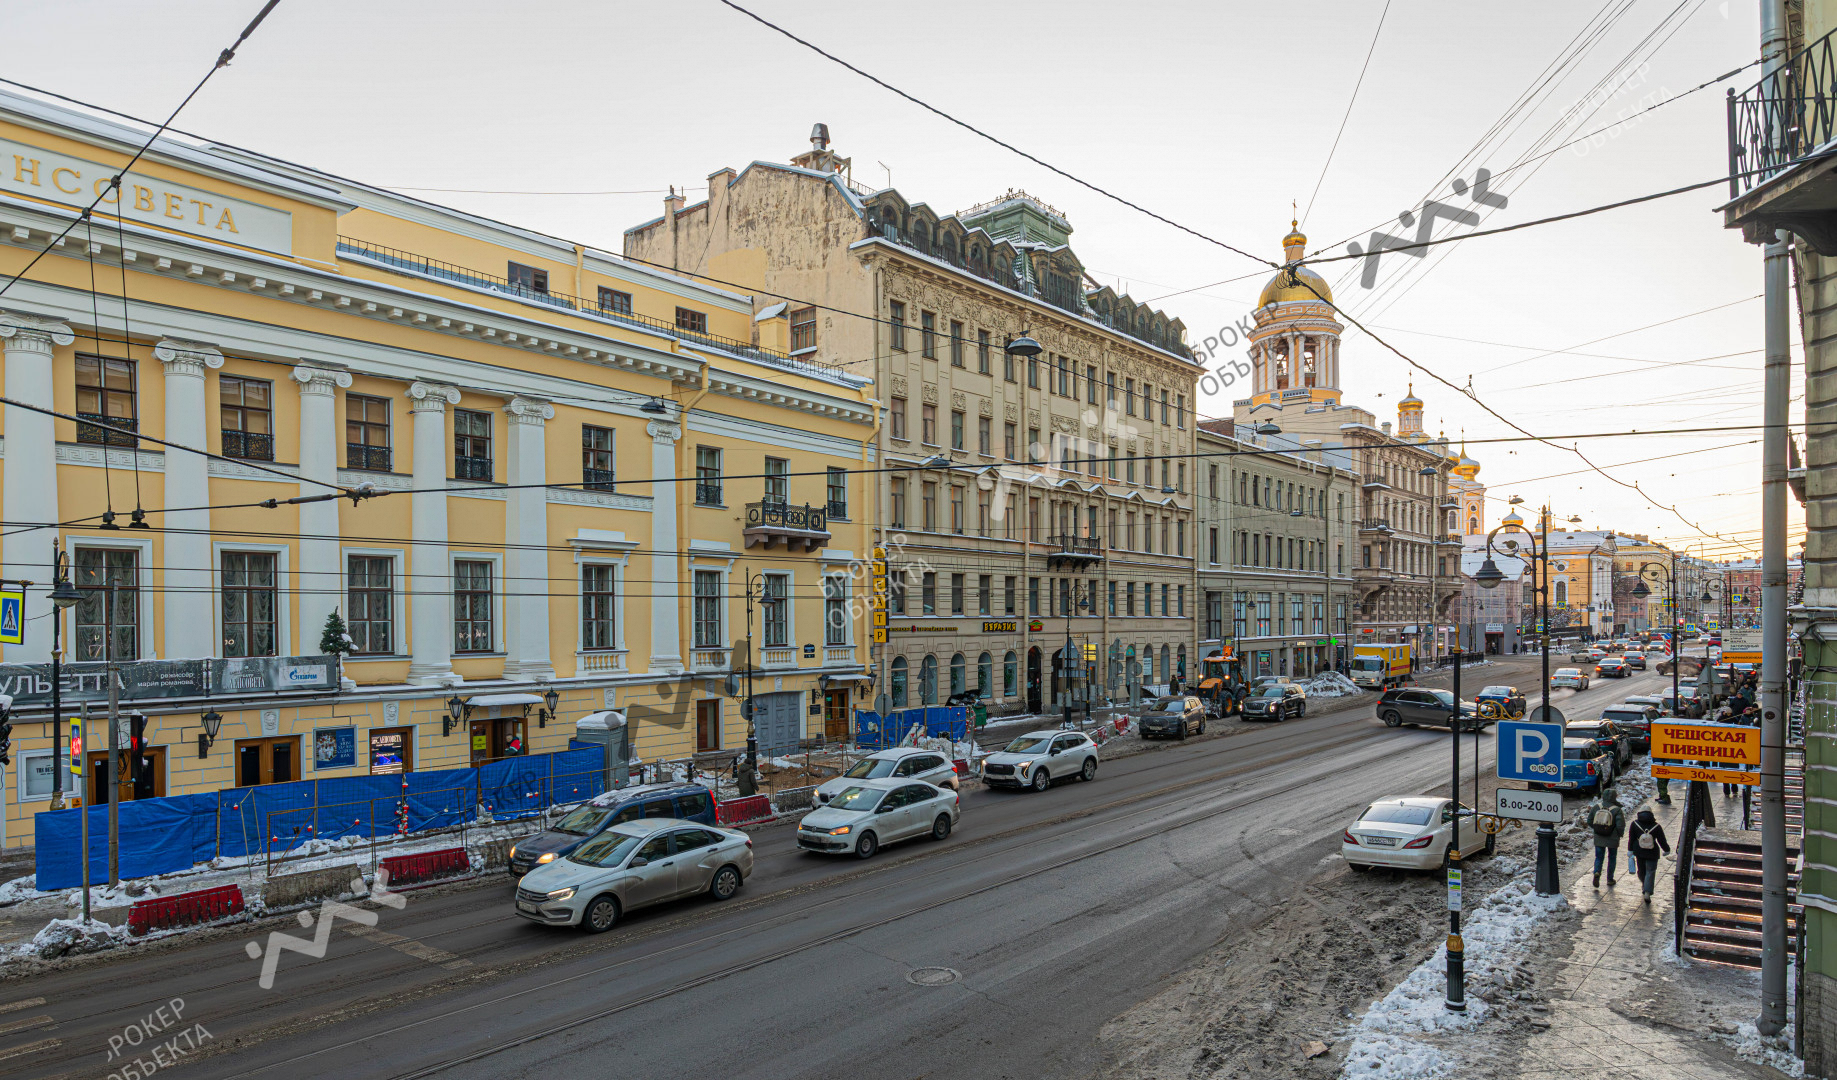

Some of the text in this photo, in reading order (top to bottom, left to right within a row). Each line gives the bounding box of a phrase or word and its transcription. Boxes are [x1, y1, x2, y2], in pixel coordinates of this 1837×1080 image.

[0, 154, 240, 234] НСОВЕТА
[875, 562, 884, 640] ТЕАТР
[1664, 728, 1747, 743] ЧЕШСКАЯ
[1663, 743, 1747, 759] ПИВНИЦА
[1500, 798, 1559, 813] 8.00-20.00
